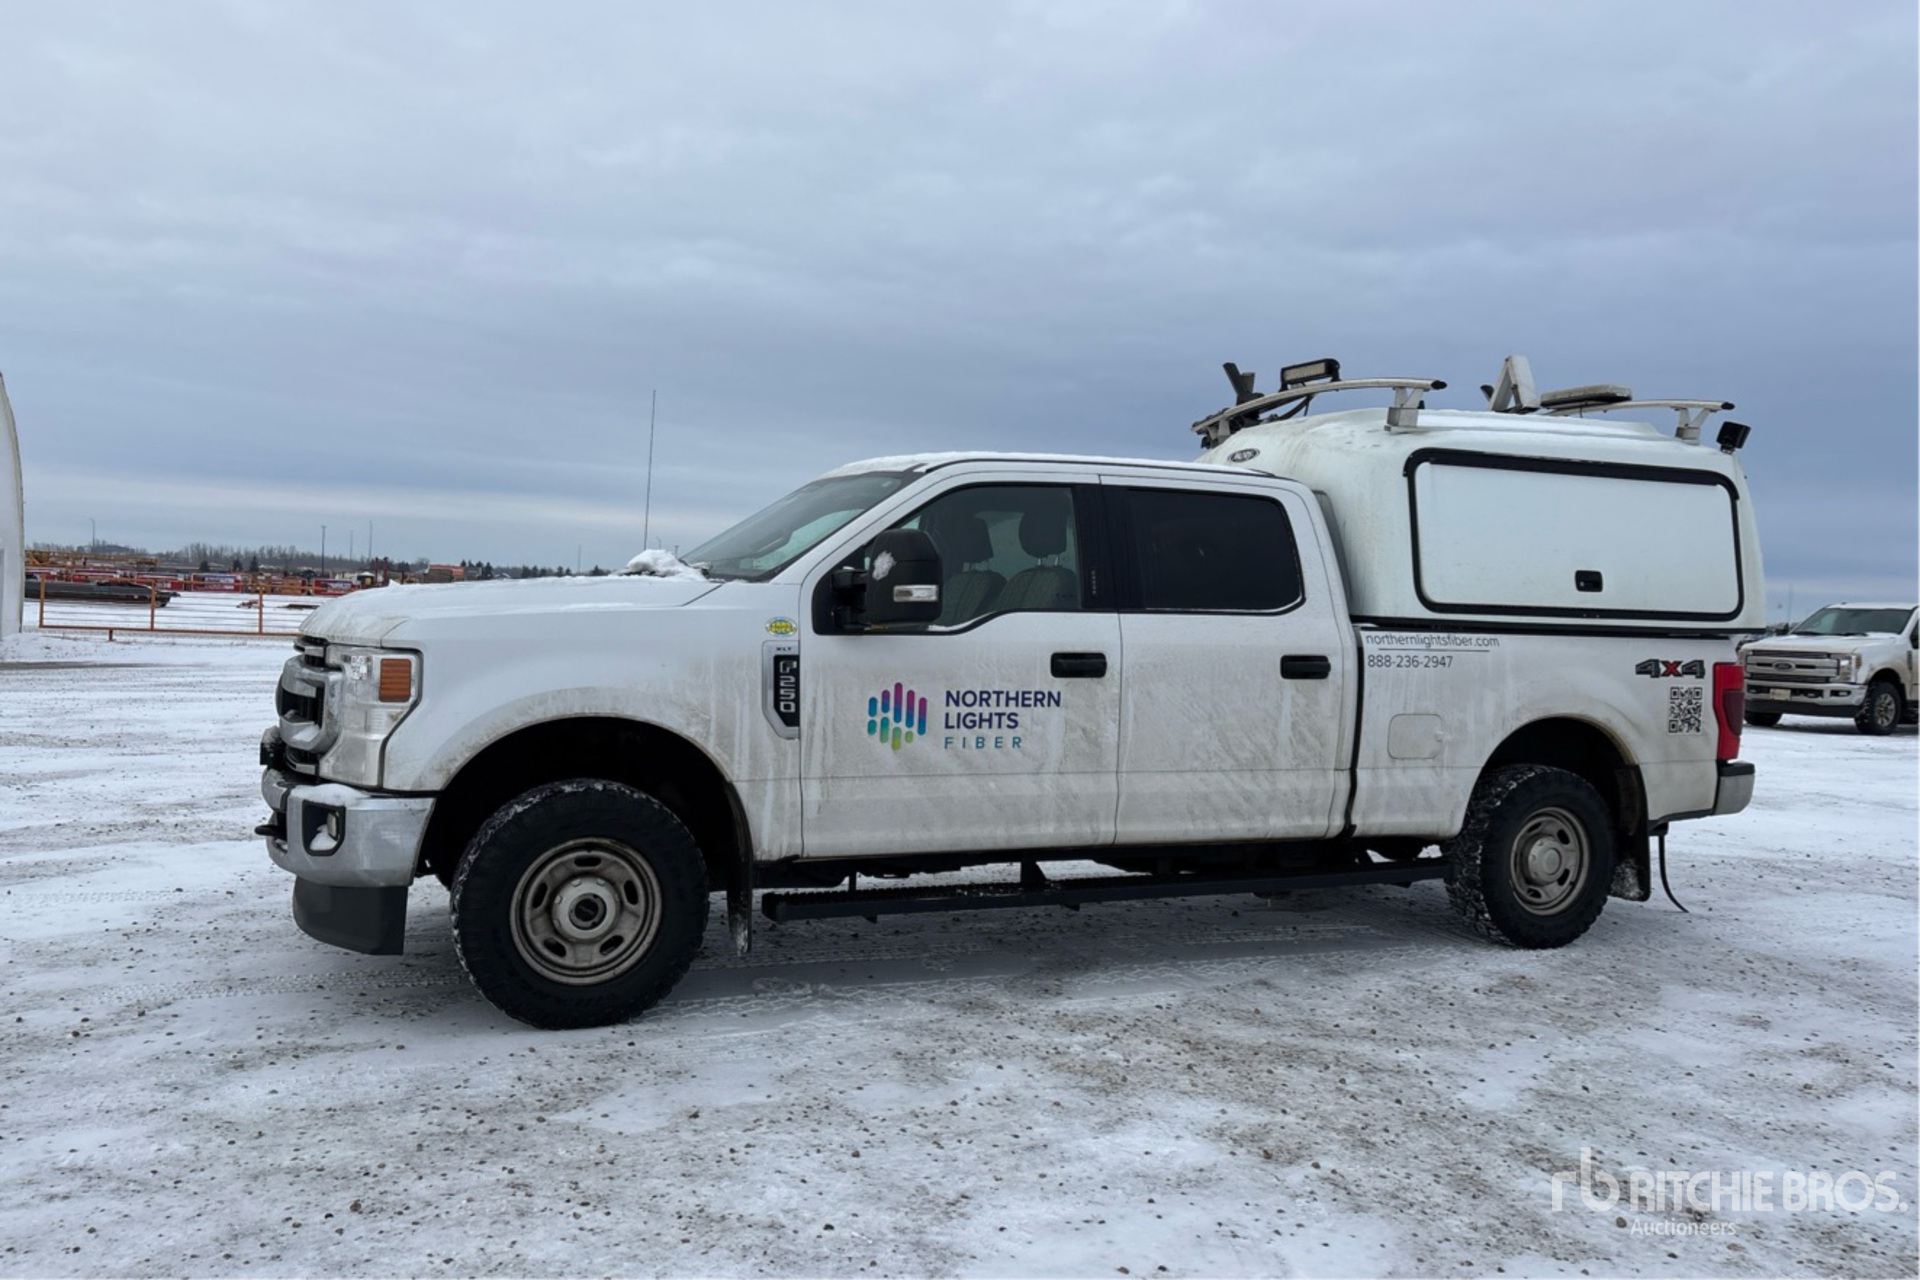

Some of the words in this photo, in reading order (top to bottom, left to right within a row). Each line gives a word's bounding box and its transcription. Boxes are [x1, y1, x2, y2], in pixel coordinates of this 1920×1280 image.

[1365, 633, 1500, 649] northernlightsfiber.com
[1367, 654, 1453, 668] 888-236-2947
[945, 690, 1061, 708] NORTHERN
[944, 712, 1019, 730] LIGHTS
[944, 736, 1022, 749] FIBER
